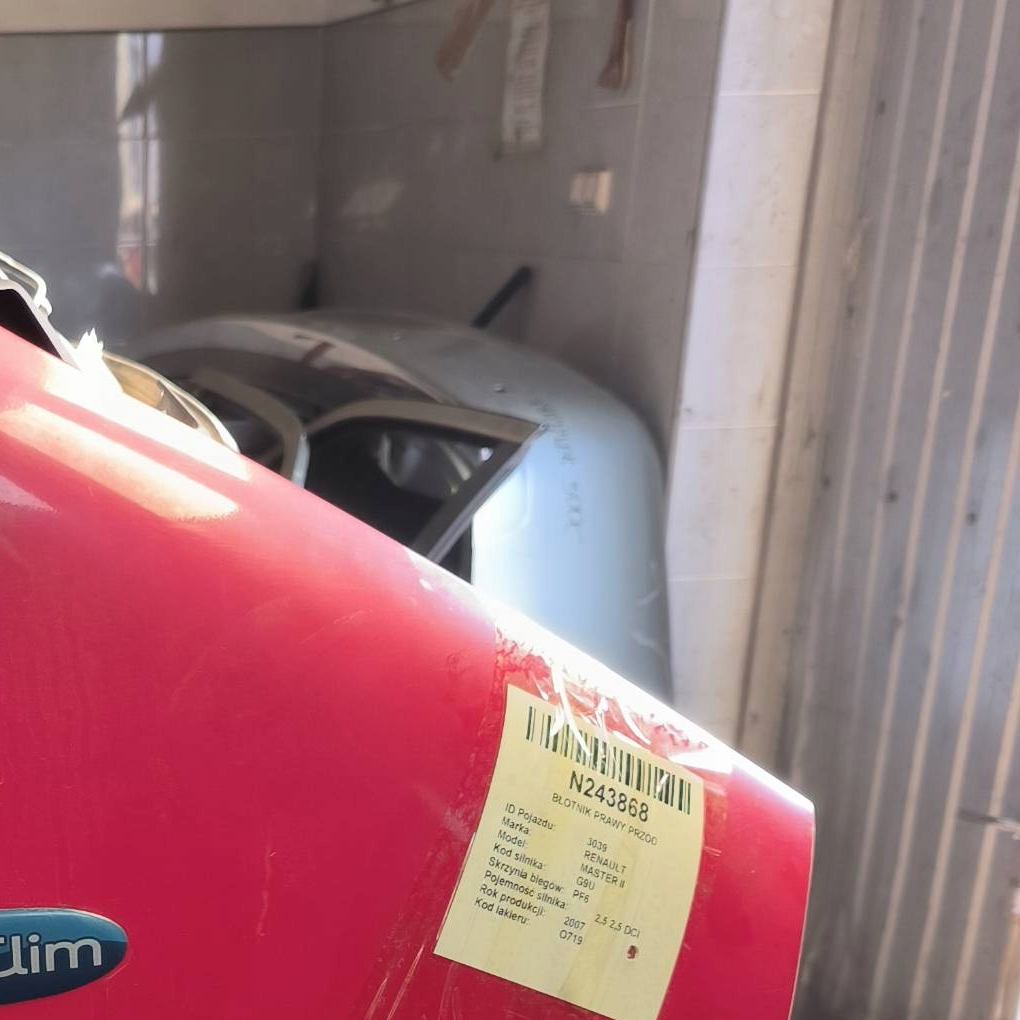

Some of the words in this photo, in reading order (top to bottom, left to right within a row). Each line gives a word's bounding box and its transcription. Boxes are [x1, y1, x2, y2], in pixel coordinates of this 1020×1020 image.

[570, 770, 649, 822] N243868
[505, 803, 515, 814] ID
[518, 809, 556, 831] Pojazdu:
[587, 837, 608, 852] 3039
[594, 811, 626, 831] PRAWY
[489, 856, 527, 879] Skrzynia
[572, 889, 590, 903] PF6
[493, 843, 512, 857] Kod
[576, 876, 596, 891] G9U
[580, 864, 618, 886] MASTER
[584, 850, 627, 874] RENAULT
[475, 897, 494, 912] Kod
[496, 905, 530, 925] lakieru:
[480, 883, 498, 898] Rok
[500, 894, 544, 917] produkcji:
[564, 916, 586, 931] 2007
